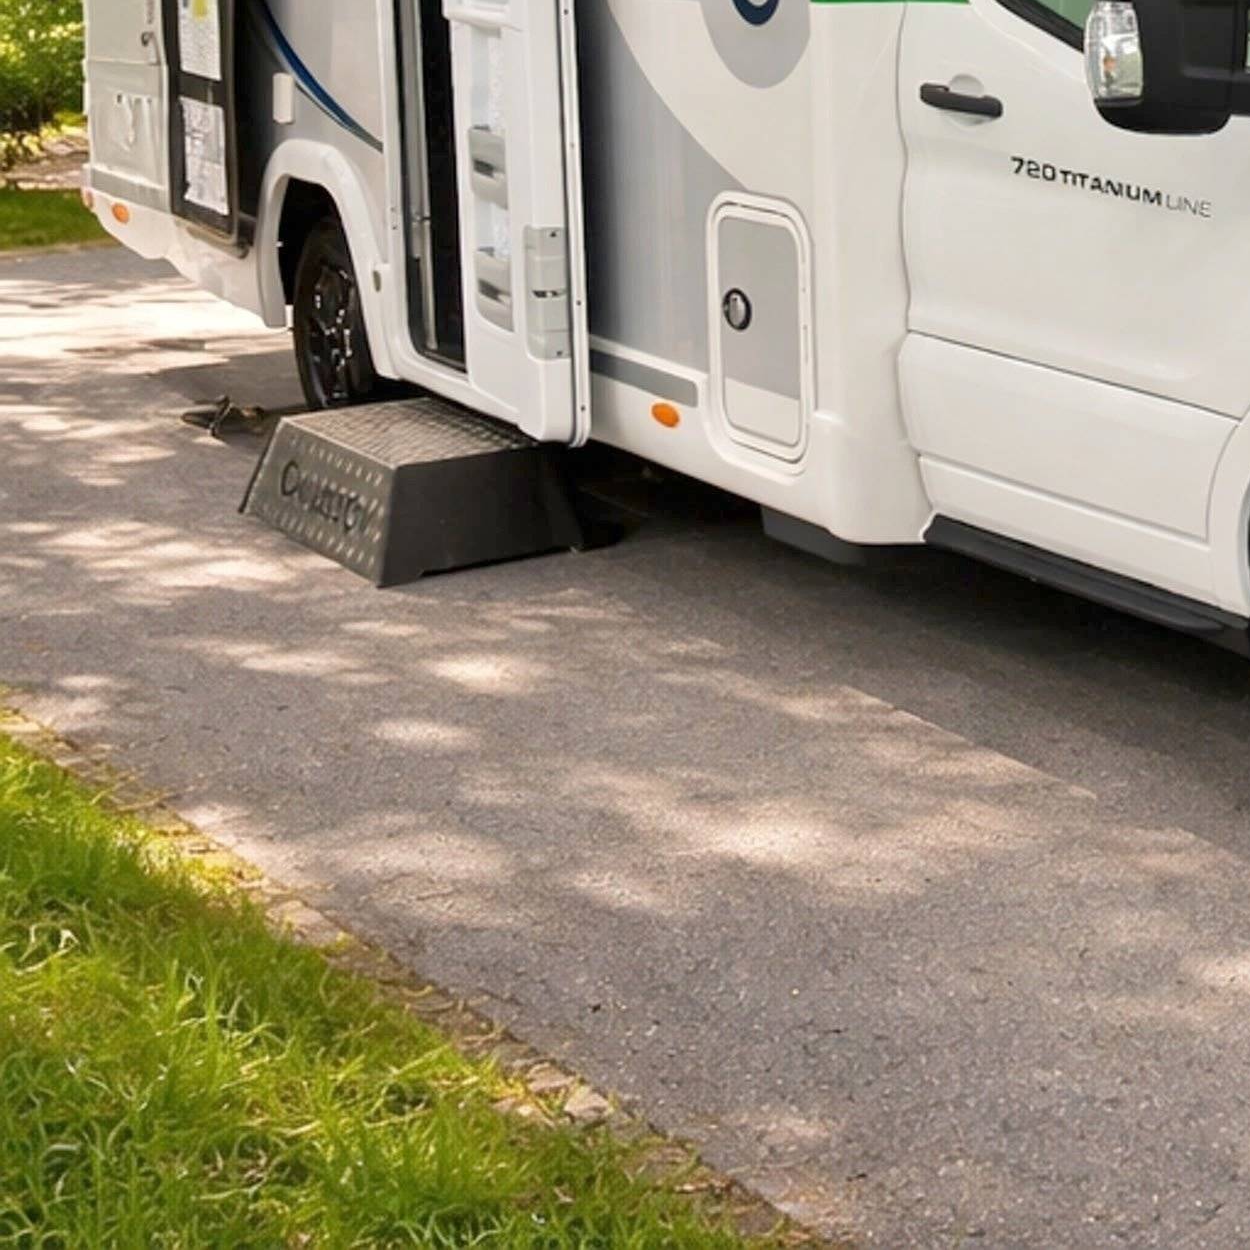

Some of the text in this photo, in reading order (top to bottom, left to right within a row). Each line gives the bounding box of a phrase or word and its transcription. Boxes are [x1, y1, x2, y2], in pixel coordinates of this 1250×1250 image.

[1010, 156, 1212, 218] 720 TITANIUM LINE
